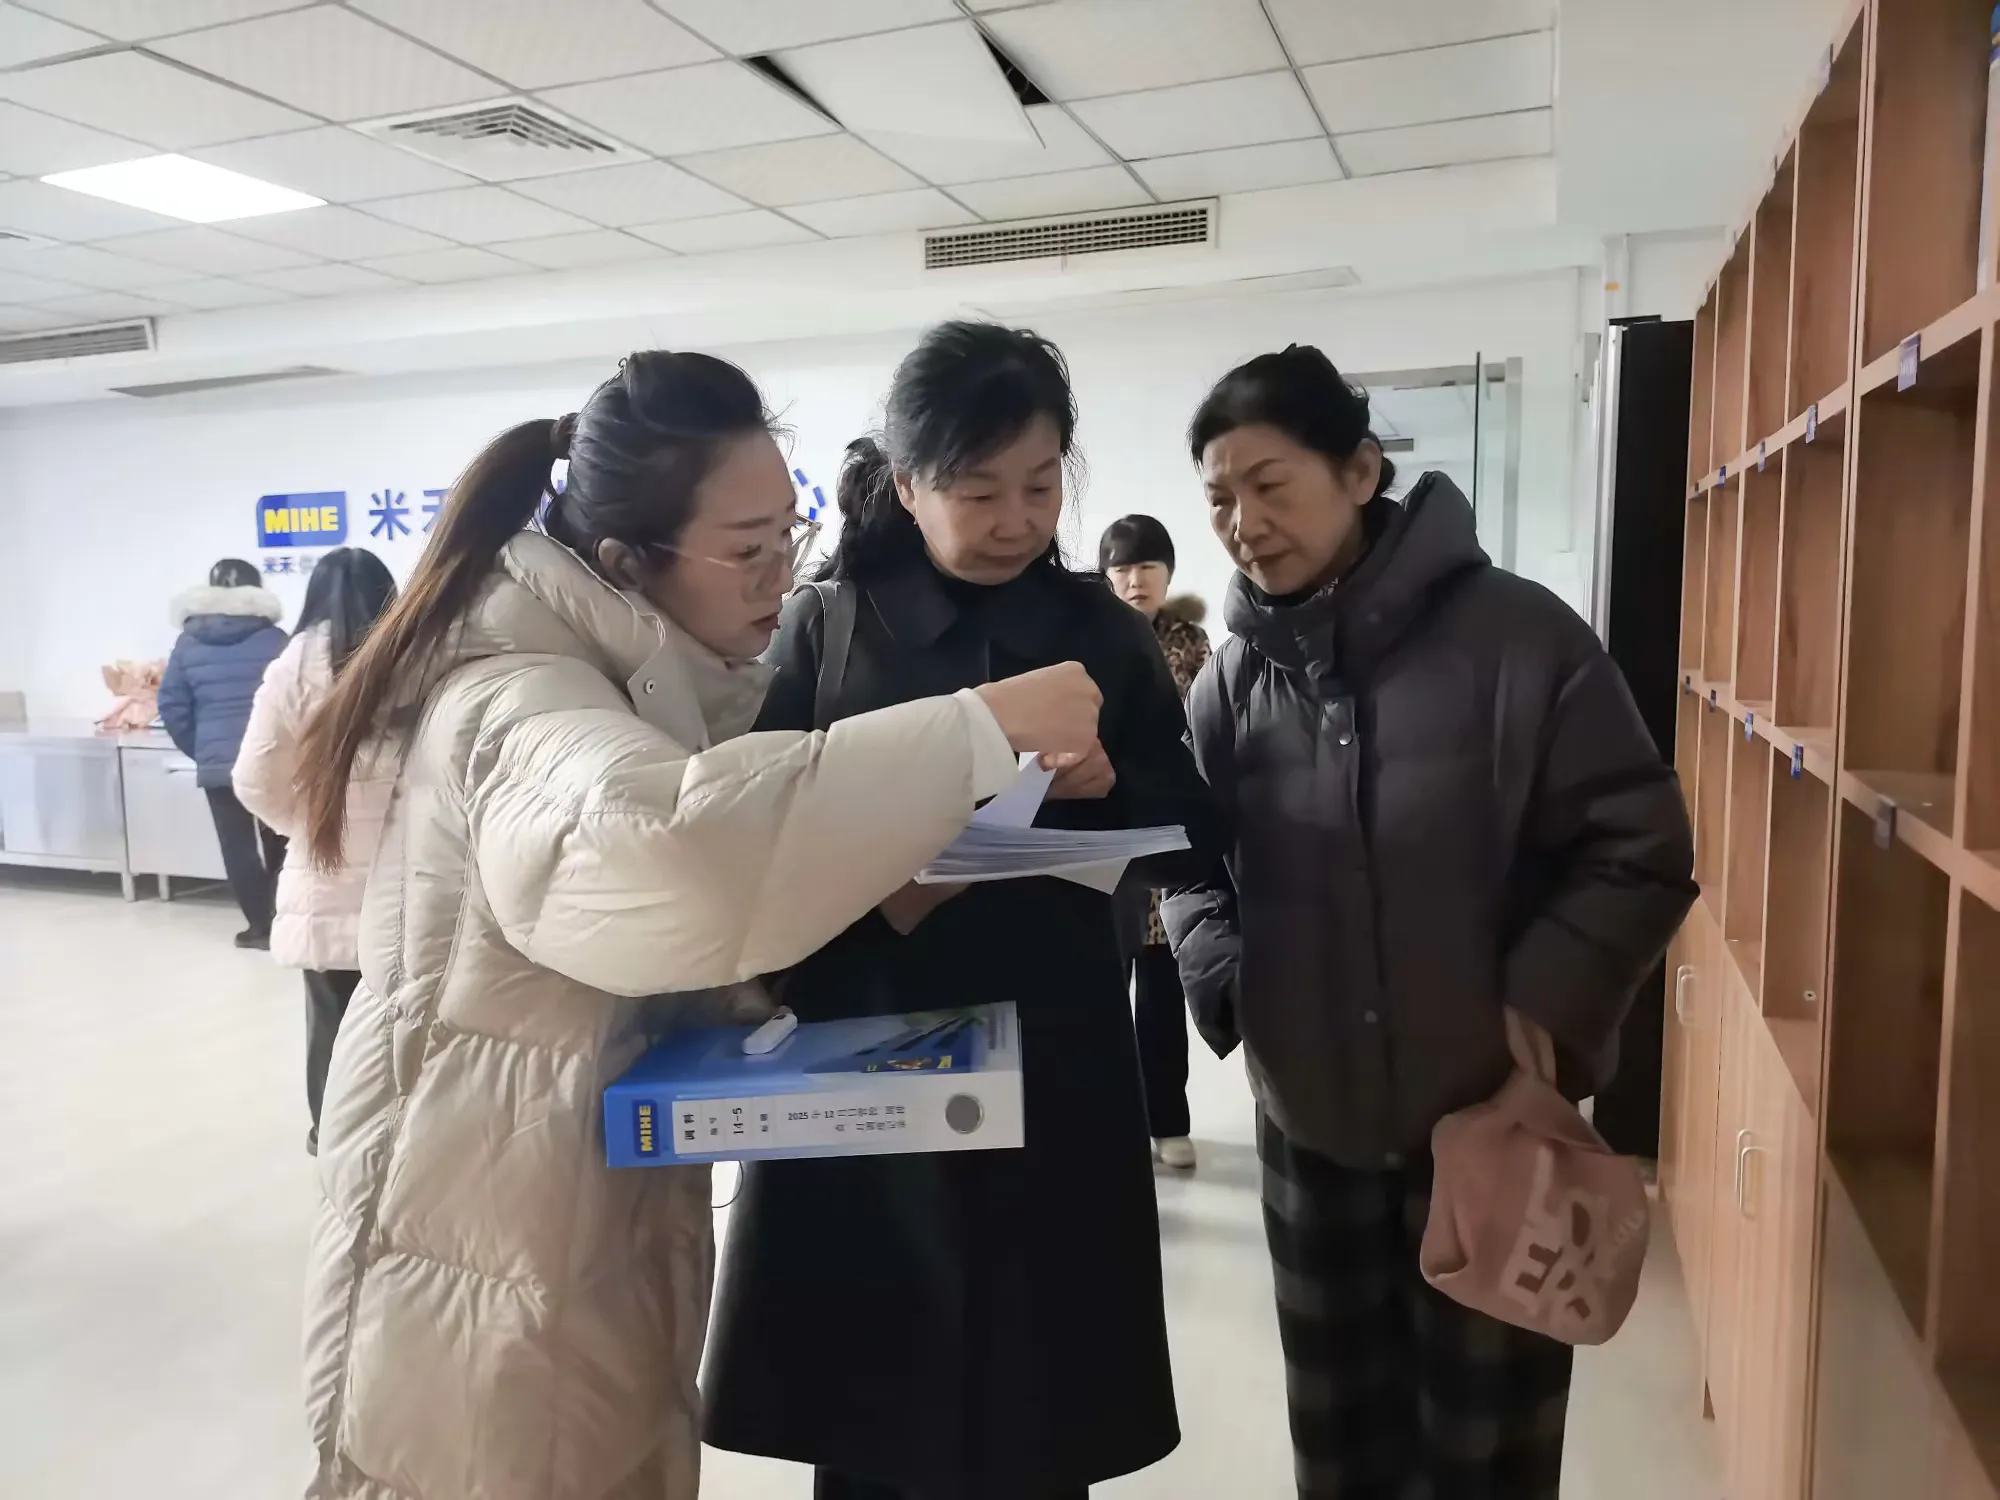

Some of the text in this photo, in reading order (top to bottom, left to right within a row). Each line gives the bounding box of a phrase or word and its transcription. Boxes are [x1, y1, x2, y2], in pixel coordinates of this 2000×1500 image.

[264, 506, 339, 534] MIHE
[639, 1104, 653, 1152] MIHE
[732, 1107, 744, 1135] 14-5
